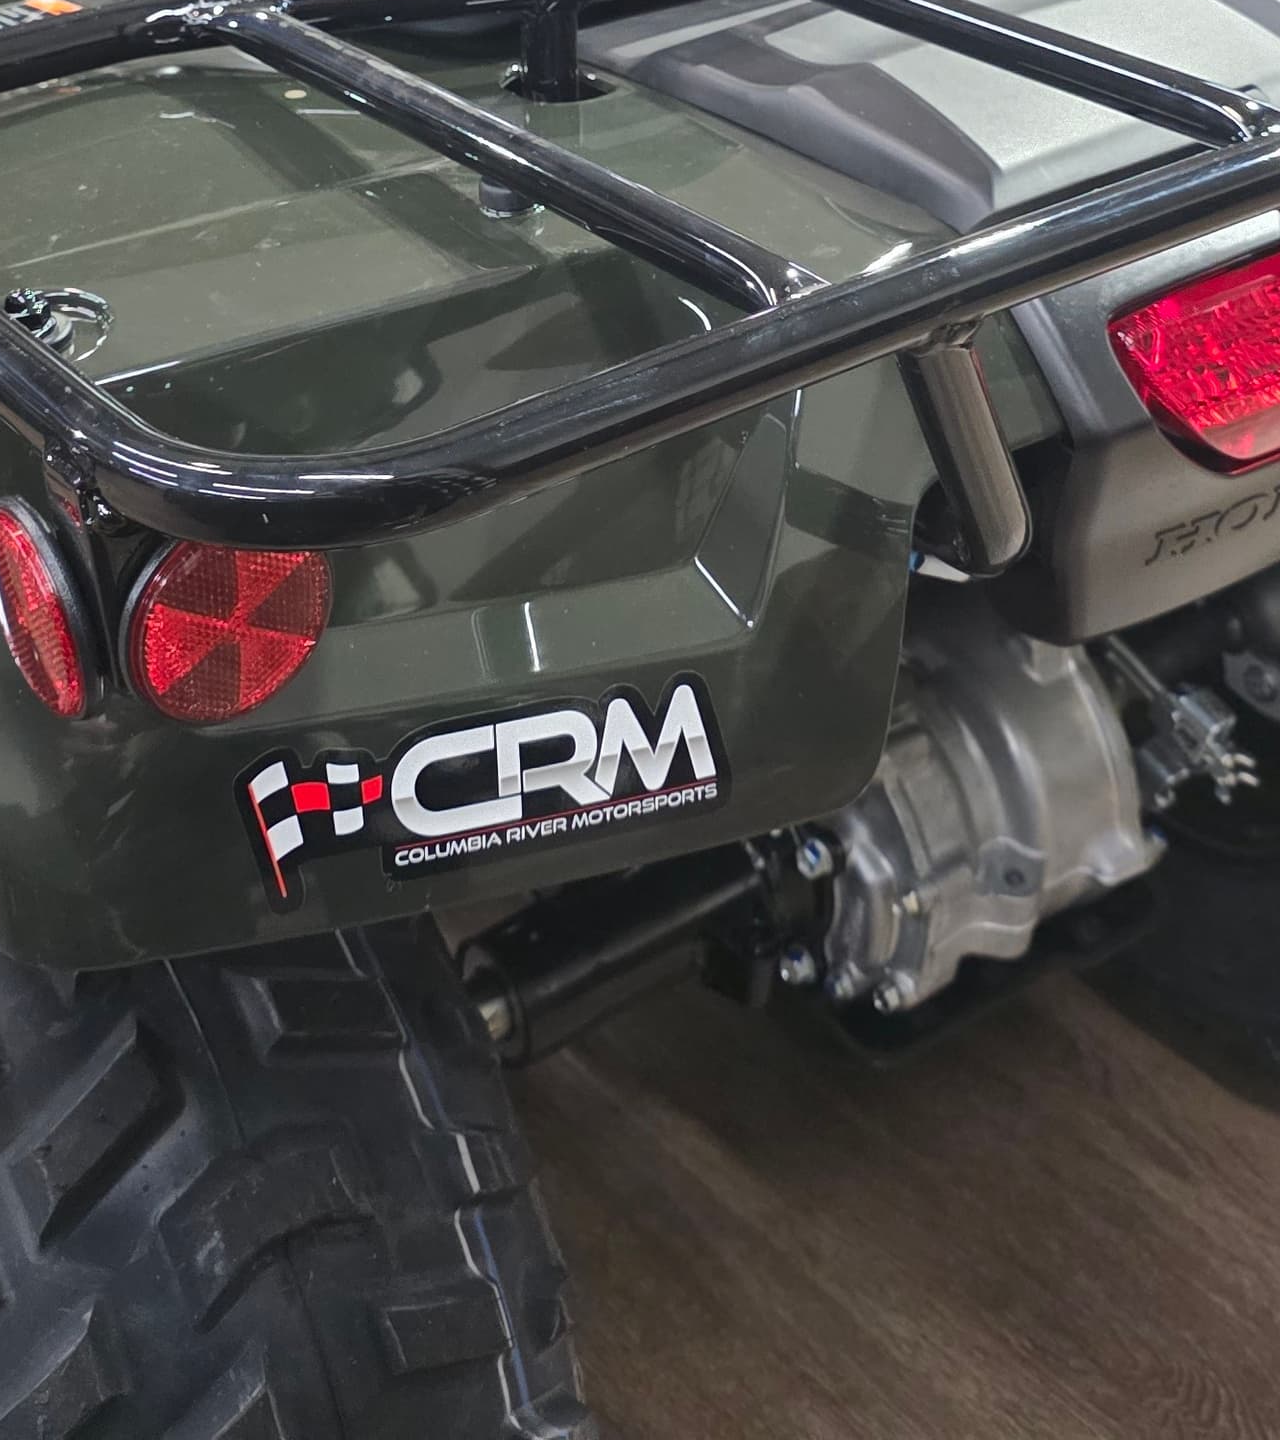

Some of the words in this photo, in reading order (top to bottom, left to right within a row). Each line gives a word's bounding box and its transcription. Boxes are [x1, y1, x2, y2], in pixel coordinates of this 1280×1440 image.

[390, 684, 717, 838] CRM
[394, 833, 502, 867] COLUMBIA
[506, 818, 567, 845] RIVER
[571, 782, 718, 830] MOTORSPORTS
